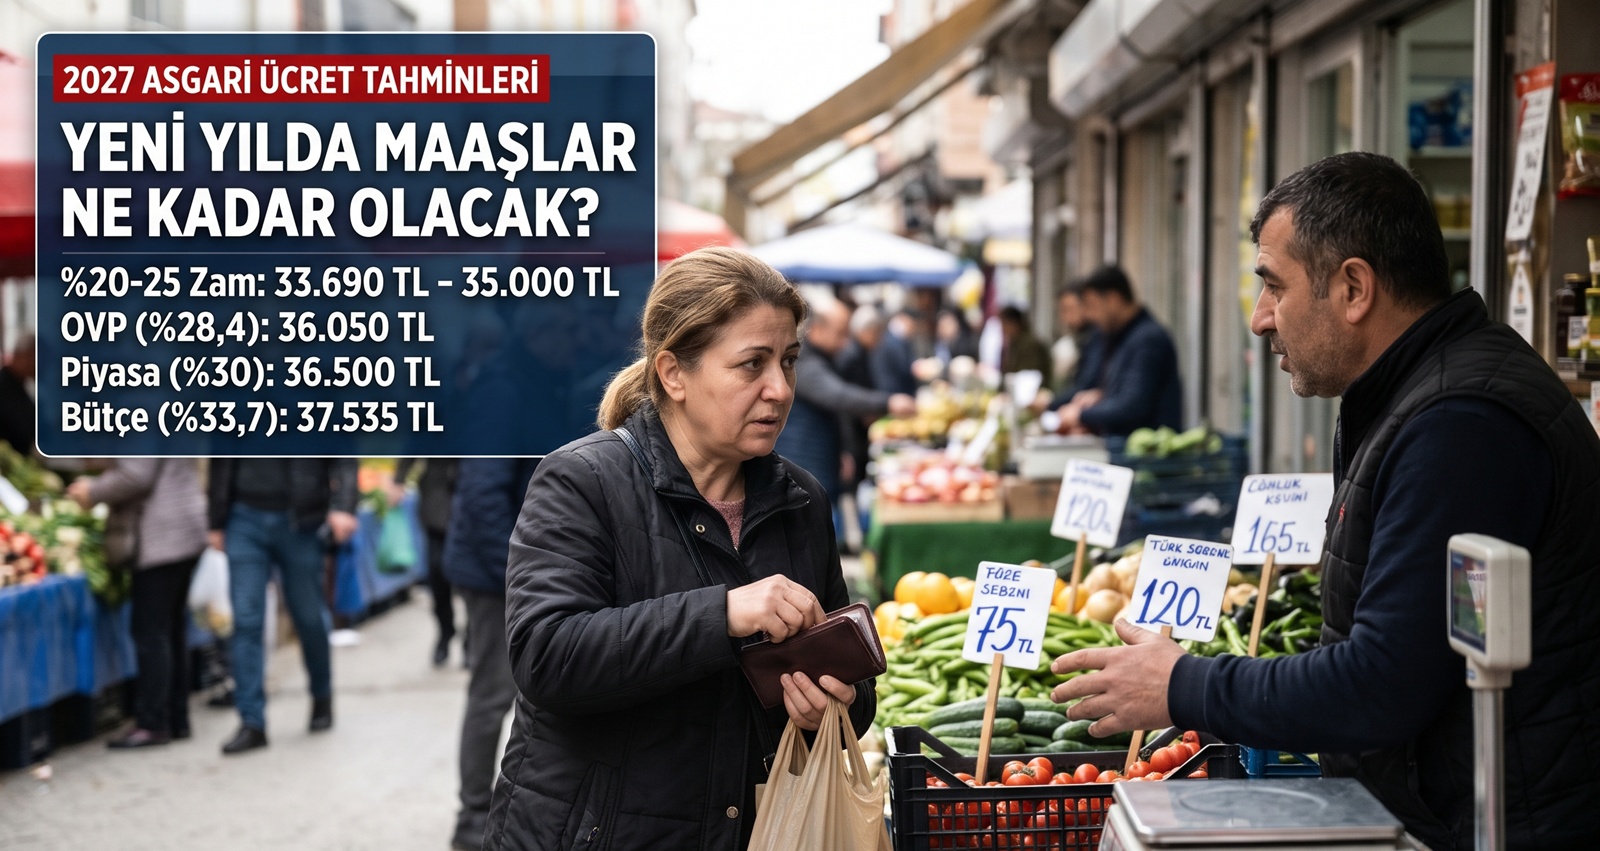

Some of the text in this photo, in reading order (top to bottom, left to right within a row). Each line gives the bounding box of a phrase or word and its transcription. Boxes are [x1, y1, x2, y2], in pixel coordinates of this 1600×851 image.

[1064, 493, 1108, 532] 120
[1150, 539, 1183, 553] TÜRK
[1243, 515, 1311, 554] 165 TL
[1135, 578, 1212, 630] 120 TL
[976, 605, 1035, 654] 75 TL
